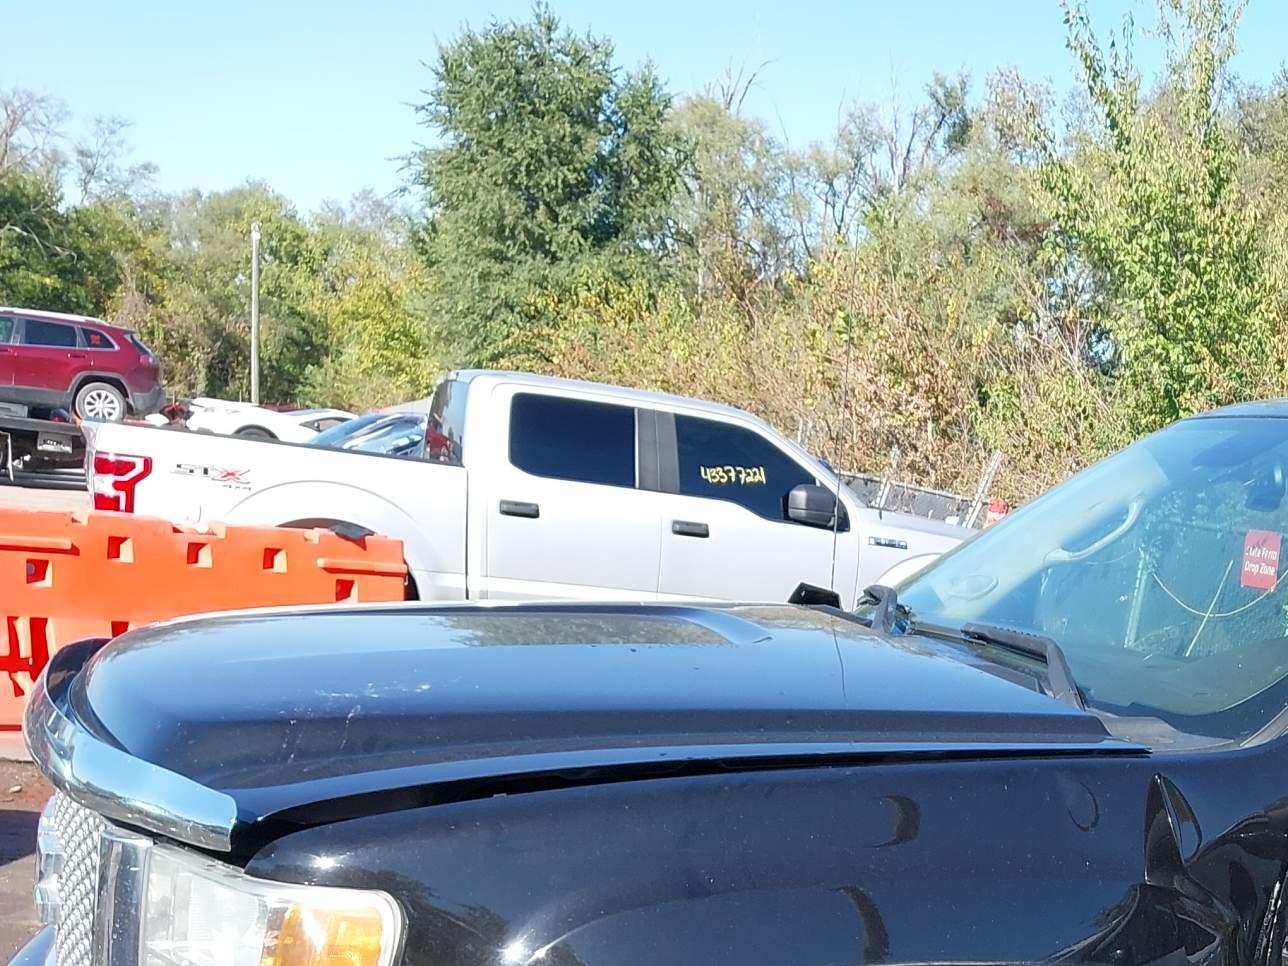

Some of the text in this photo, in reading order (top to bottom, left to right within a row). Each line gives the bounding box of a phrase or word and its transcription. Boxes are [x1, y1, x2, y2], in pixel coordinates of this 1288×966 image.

[699, 465, 766, 484] 43377221
[1244, 560, 1276, 577] Drop Zone
